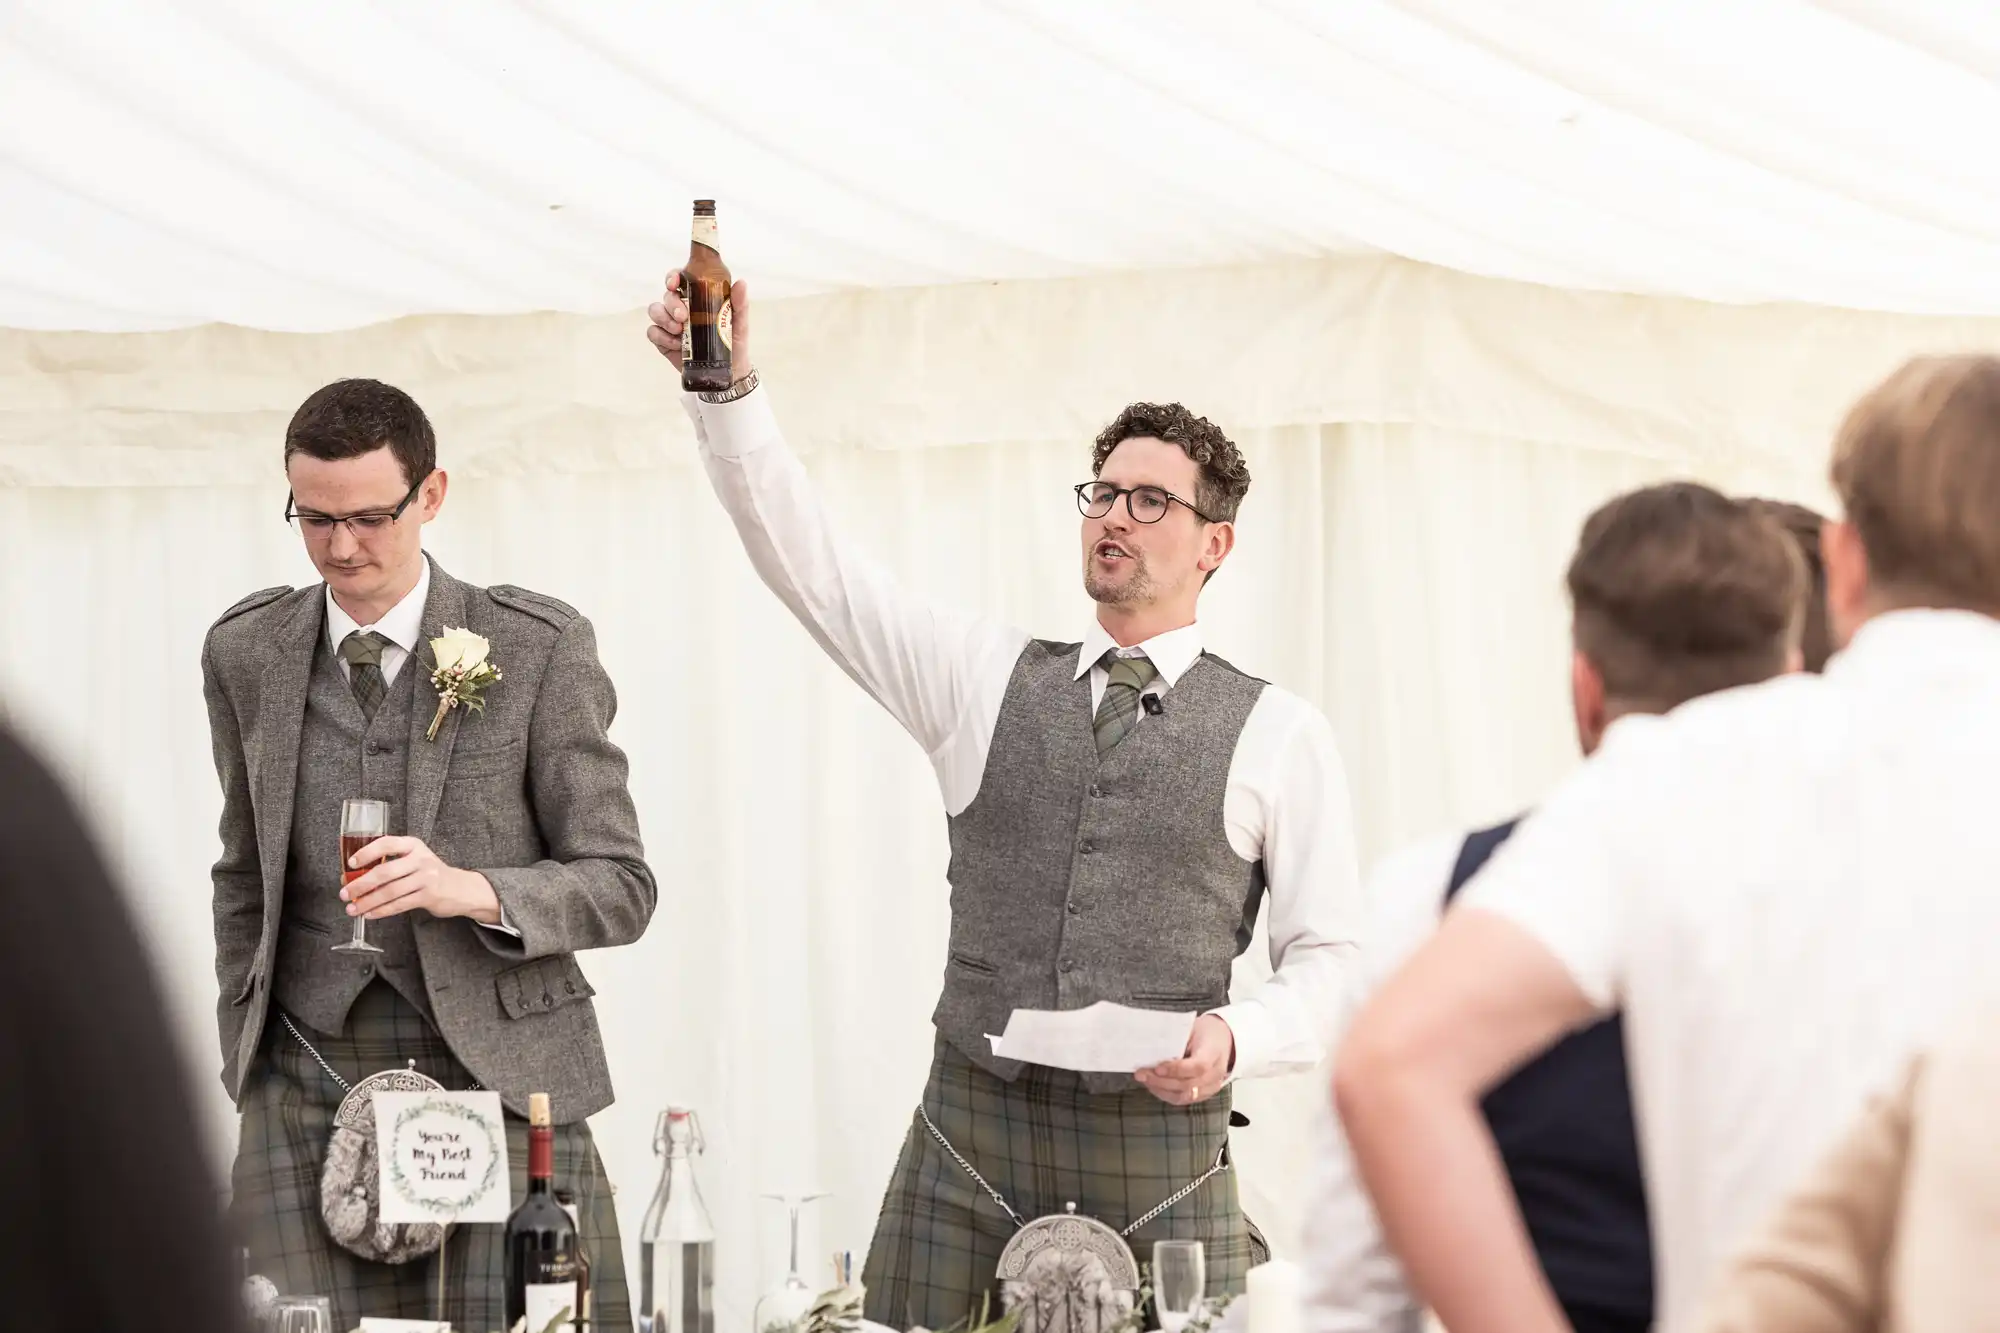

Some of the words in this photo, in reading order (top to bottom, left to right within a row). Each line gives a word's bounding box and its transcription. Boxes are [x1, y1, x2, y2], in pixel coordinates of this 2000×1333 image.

[413, 1148, 435, 1166] My
[442, 1147, 471, 1161] Best
[419, 1168, 467, 1180] Friend
